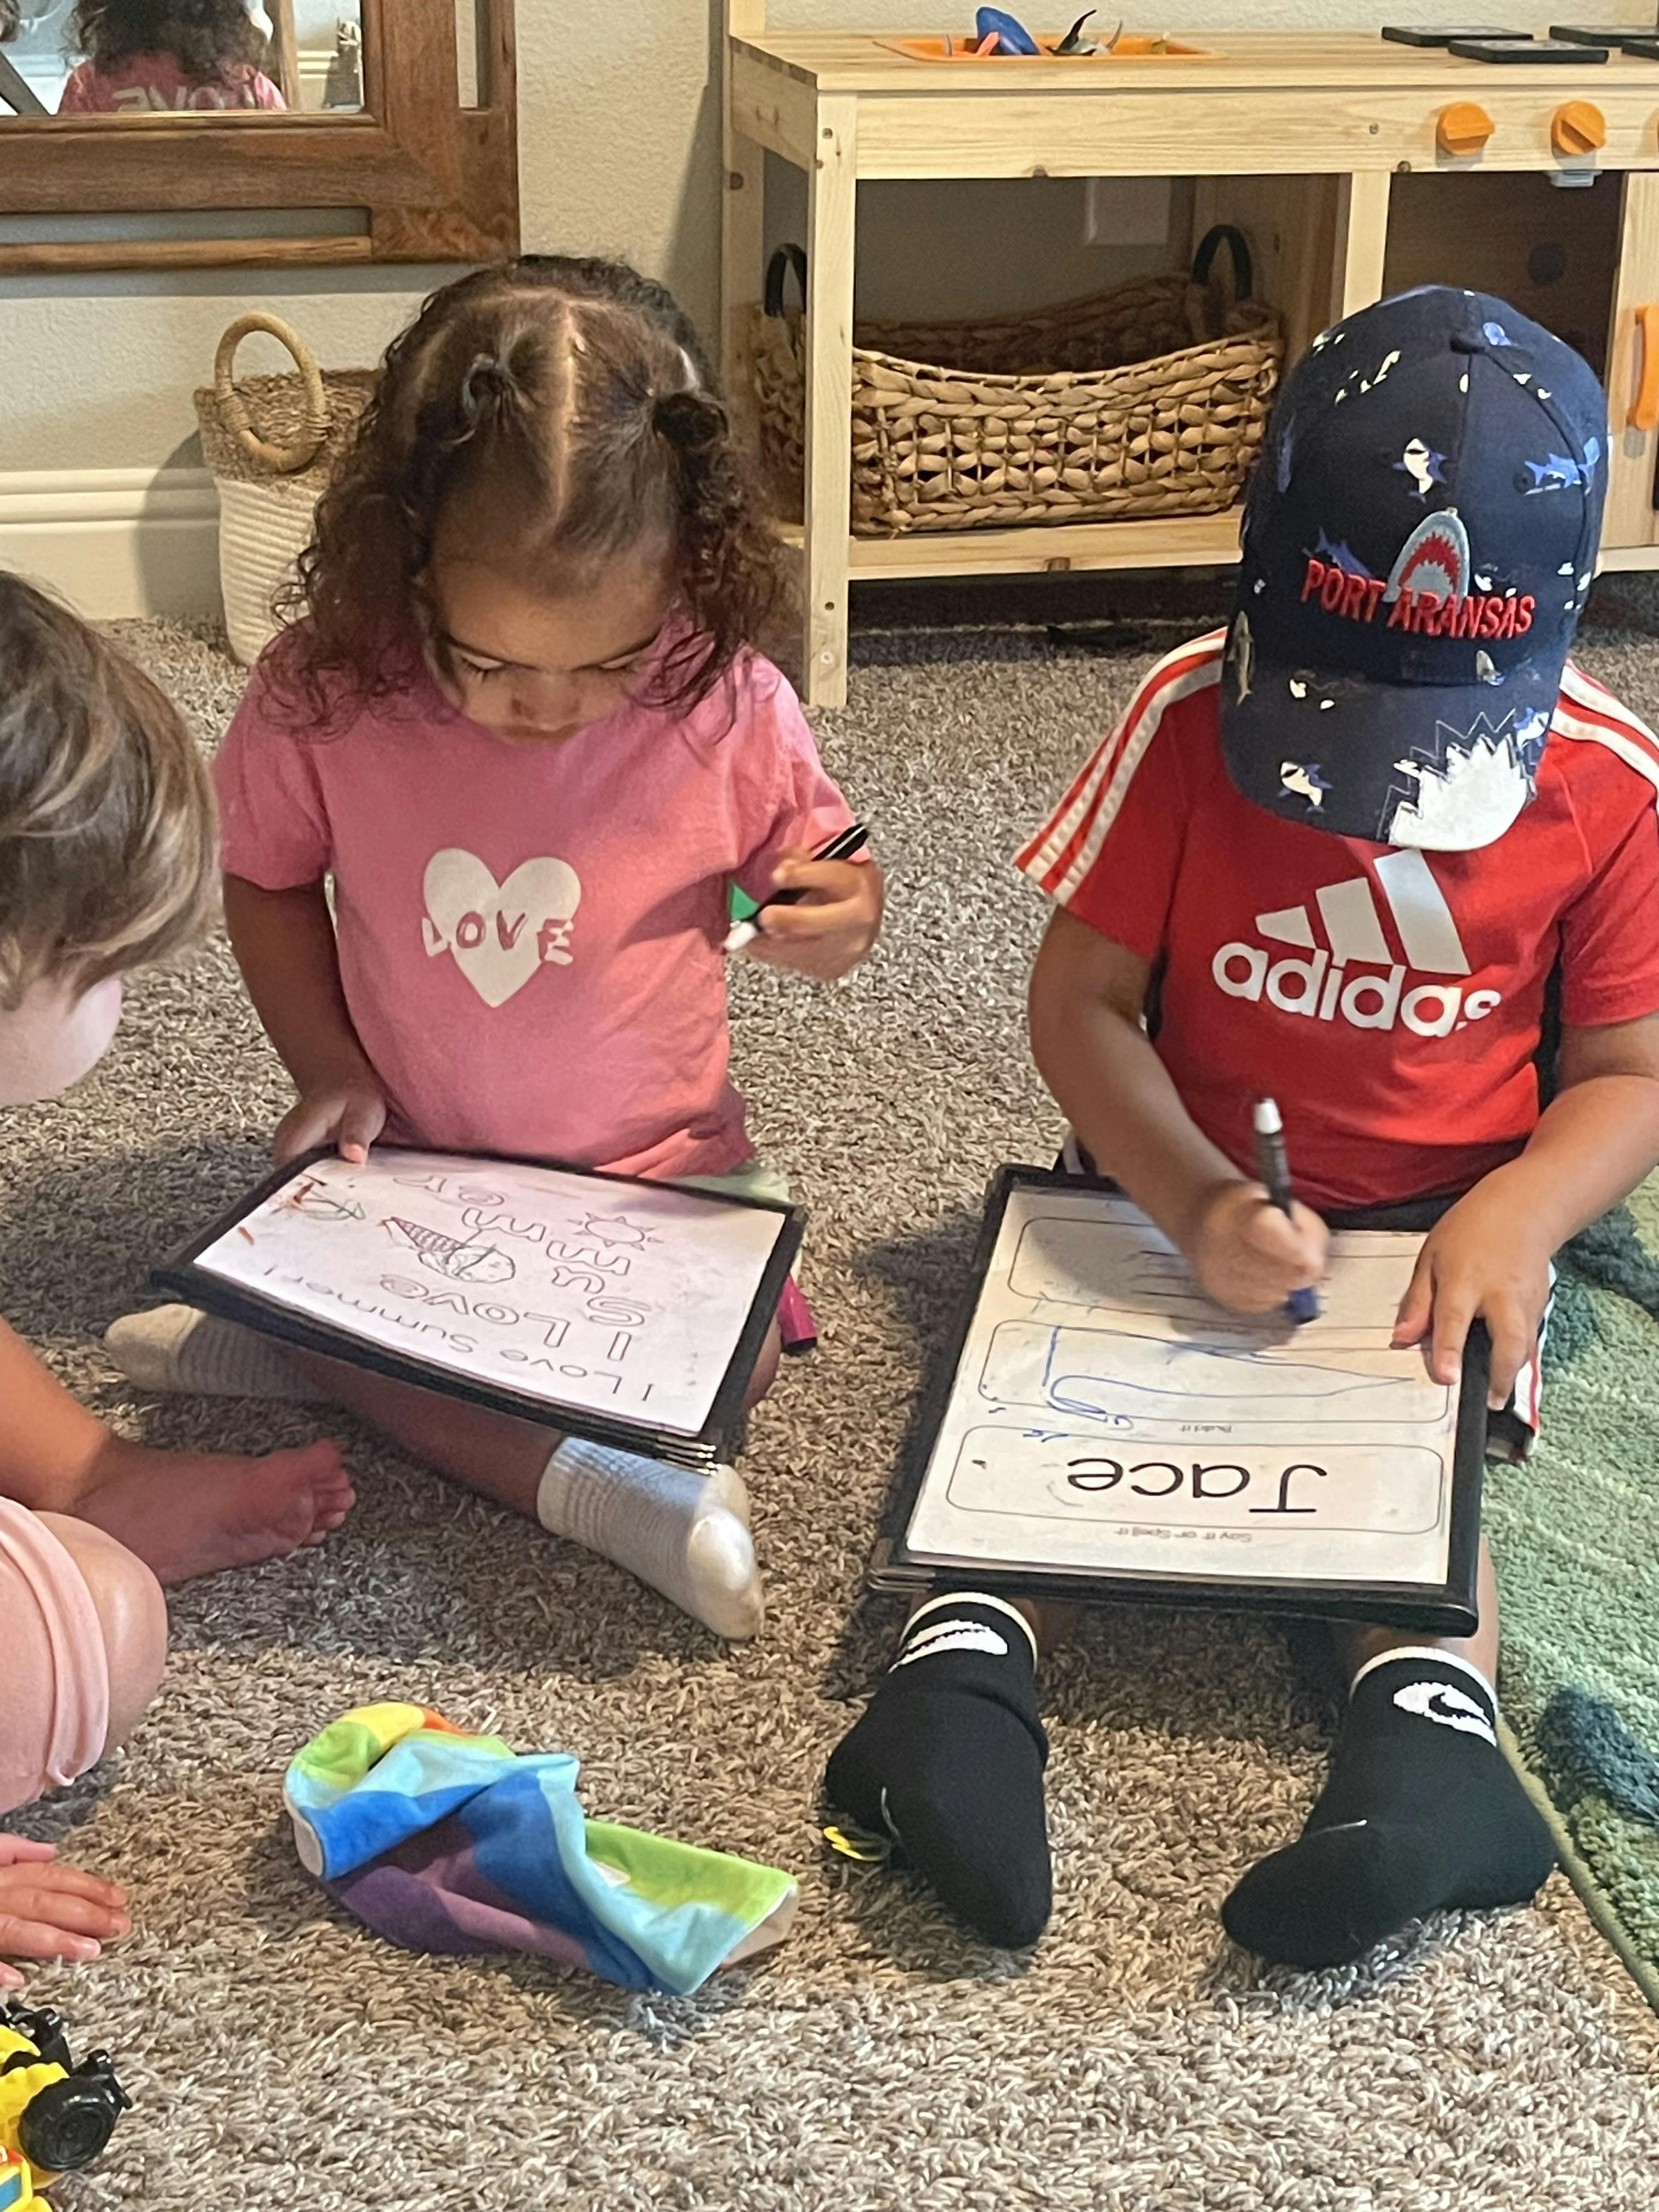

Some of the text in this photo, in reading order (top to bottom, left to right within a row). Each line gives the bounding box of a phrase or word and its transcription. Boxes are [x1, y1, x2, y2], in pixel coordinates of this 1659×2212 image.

[1299, 558, 1536, 639] PORT ARANSAS
[421, 909, 574, 966] LOVE
[379, 1273, 632, 1361] I Love
[500, 1349, 622, 1395] Love
[641, 1383, 655, 1402] I
[1067, 1457, 1328, 1513] Jace
[1174, 1531, 1197, 1539] or
[1219, 1531, 1252, 1543] Say
